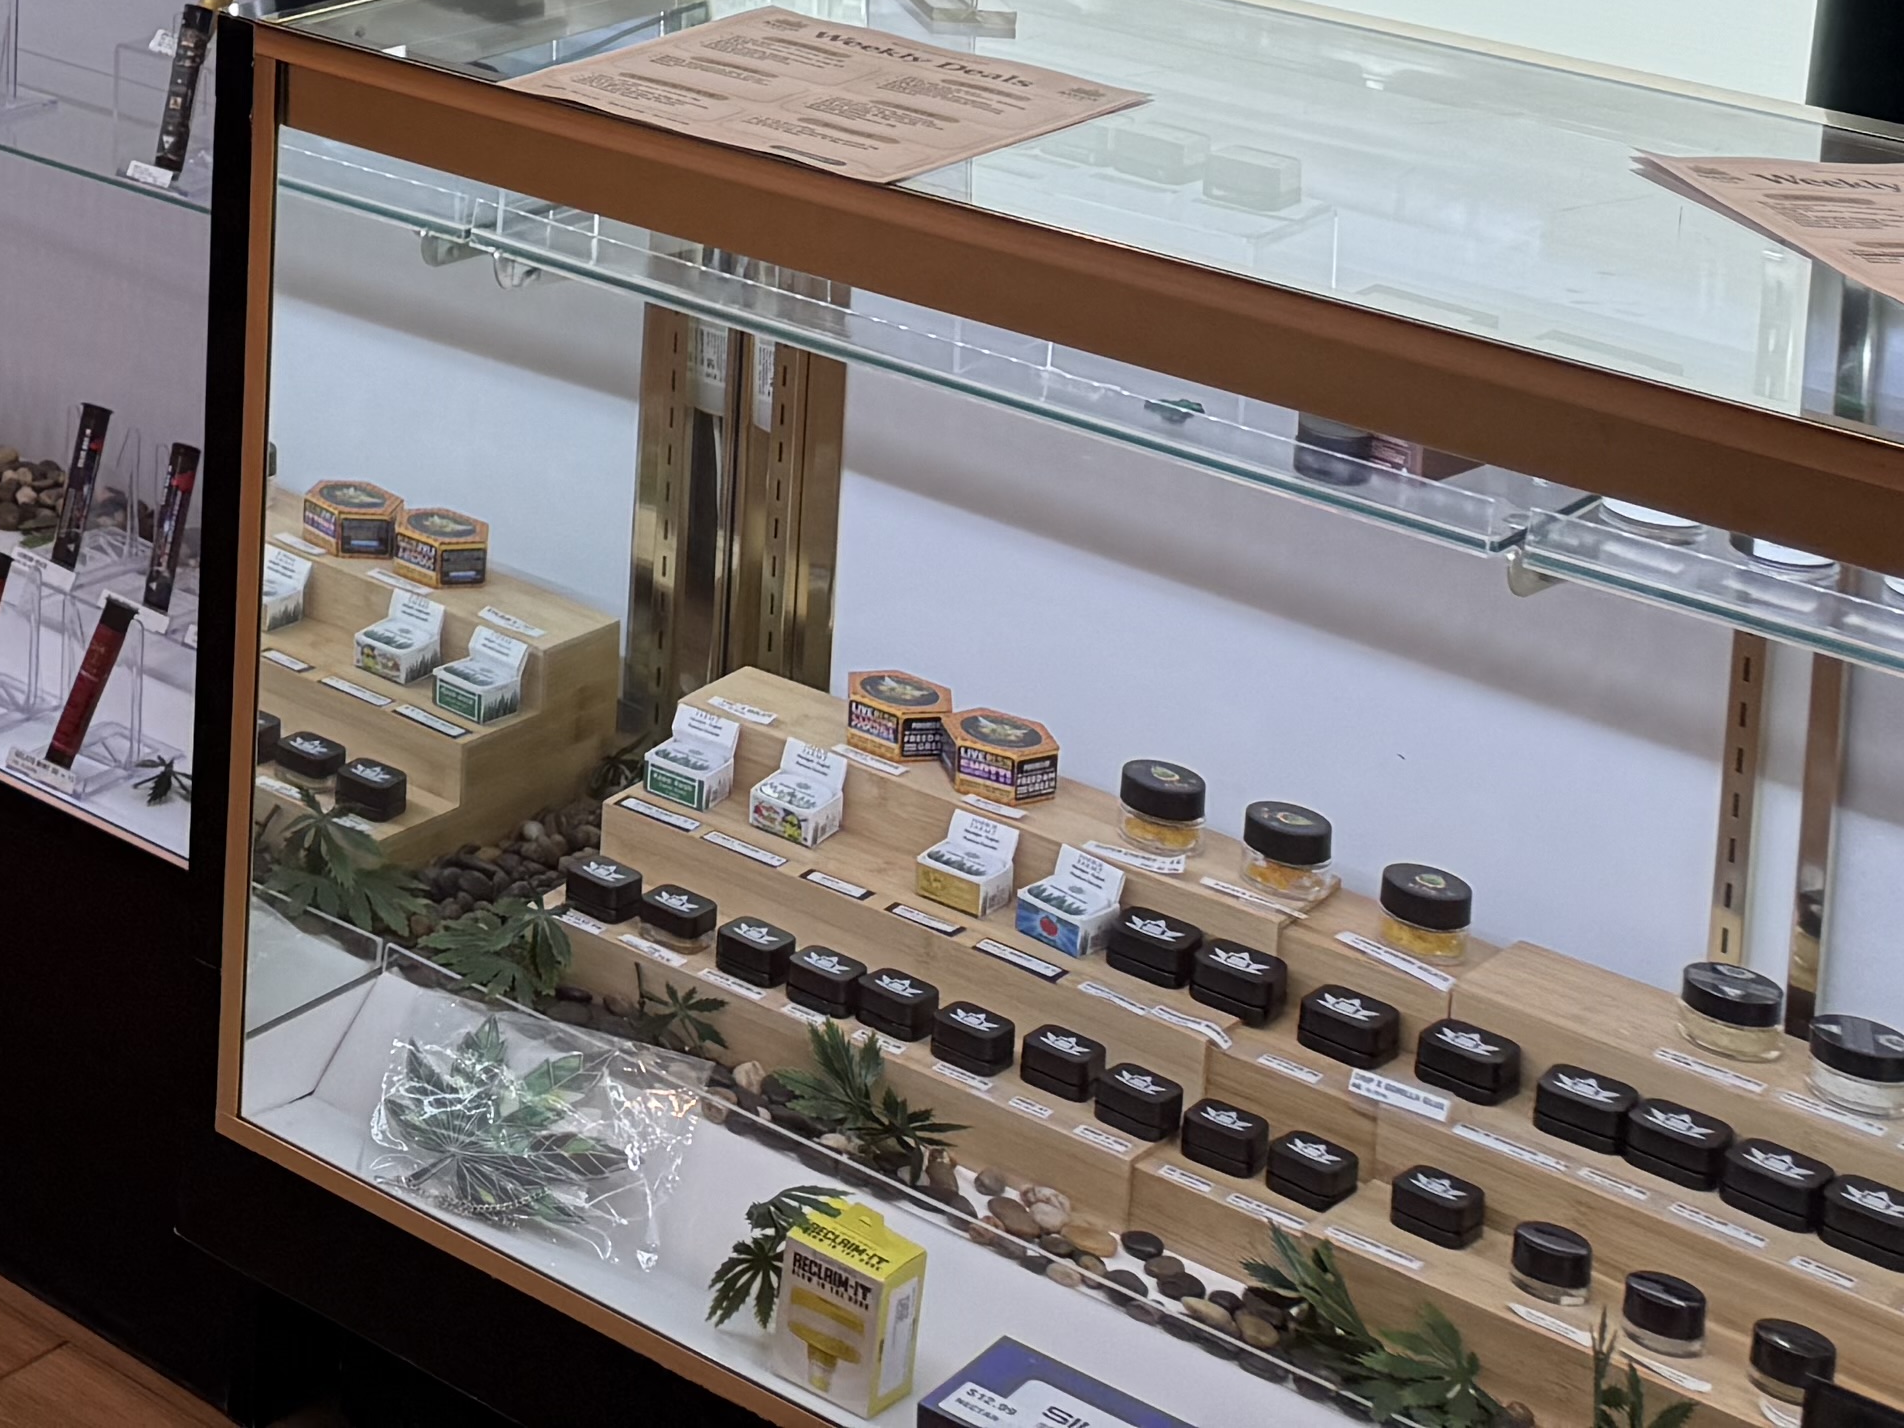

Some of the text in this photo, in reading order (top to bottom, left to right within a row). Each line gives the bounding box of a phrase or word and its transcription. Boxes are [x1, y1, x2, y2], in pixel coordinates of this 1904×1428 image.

[814, 30, 1034, 89] Weekly Deals
[1748, 172, 1903, 194] Weekly
[851, 701, 873, 717] LIVE
[960, 746, 986, 763] LIVE
[809, 1221, 890, 1266] RECLAIM-IT
[792, 1251, 873, 1302] RECLAIM-IT
[954, 1396, 1000, 1423] NECTAR
[965, 1386, 1018, 1417] $12.99
